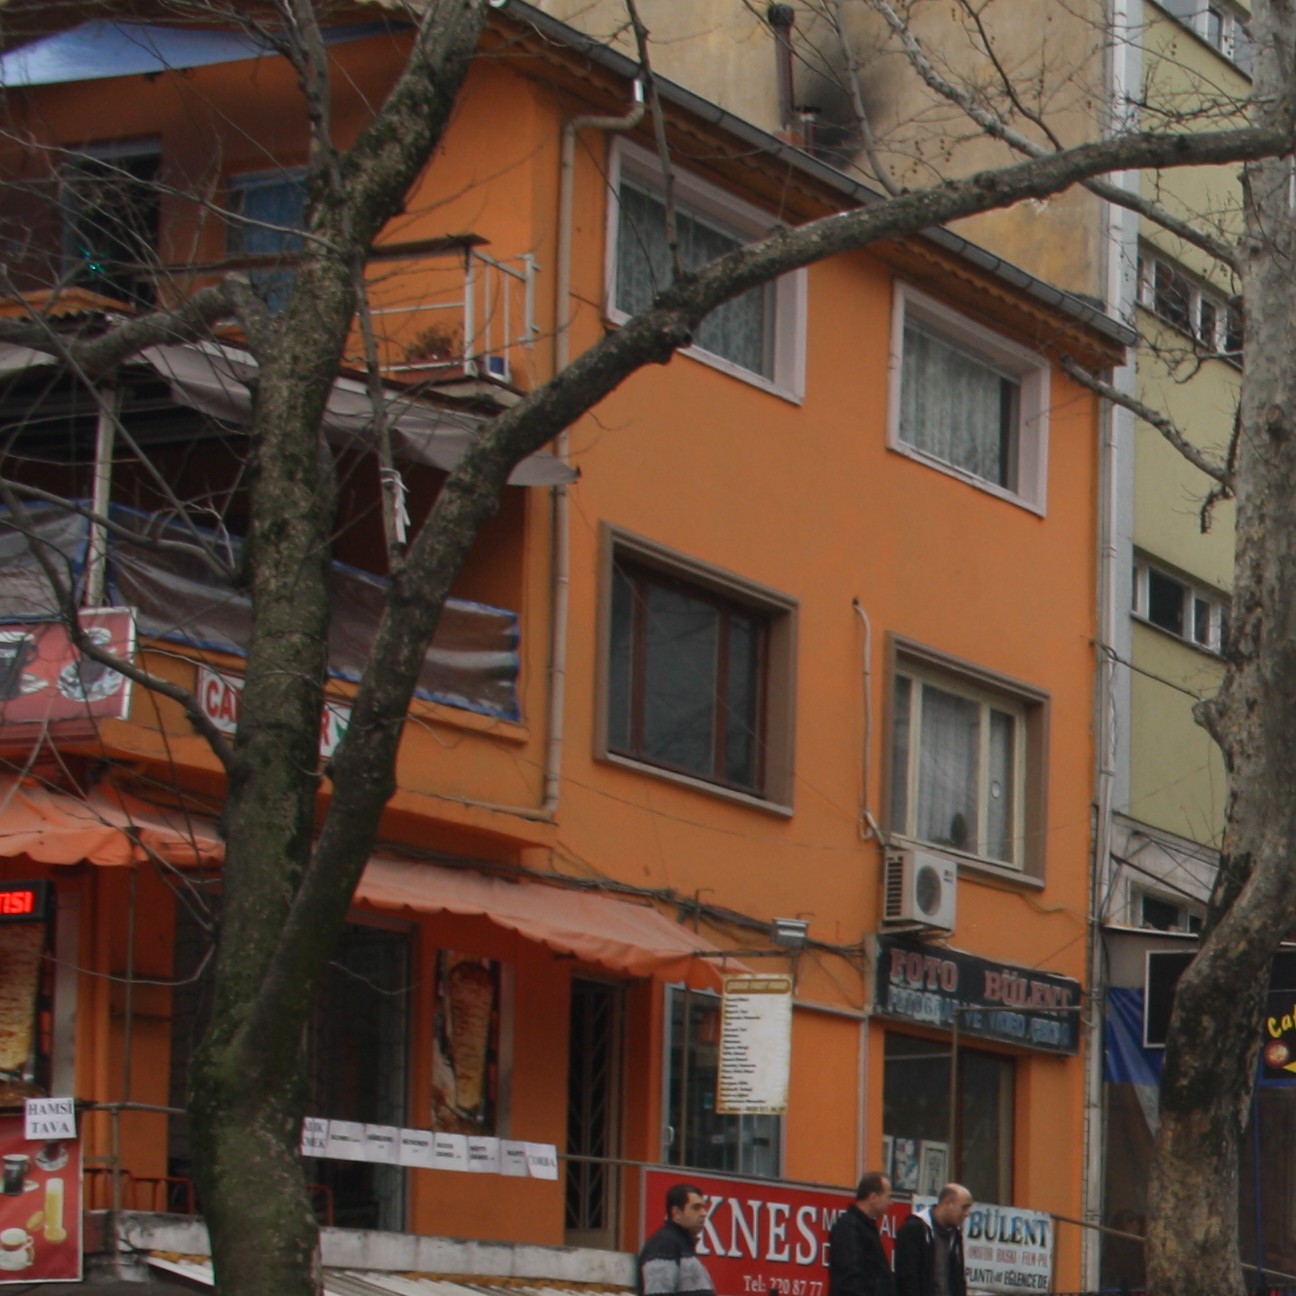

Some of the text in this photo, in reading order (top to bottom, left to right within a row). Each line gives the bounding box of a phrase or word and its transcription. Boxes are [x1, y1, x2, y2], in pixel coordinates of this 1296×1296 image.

[889, 947, 1073, 1018] FOTO BÜLENT
[31, 1122, 70, 1134] TAVA
[967, 1208, 1049, 1248] BÜLENT
[792, 1279, 807, 1296] 87
